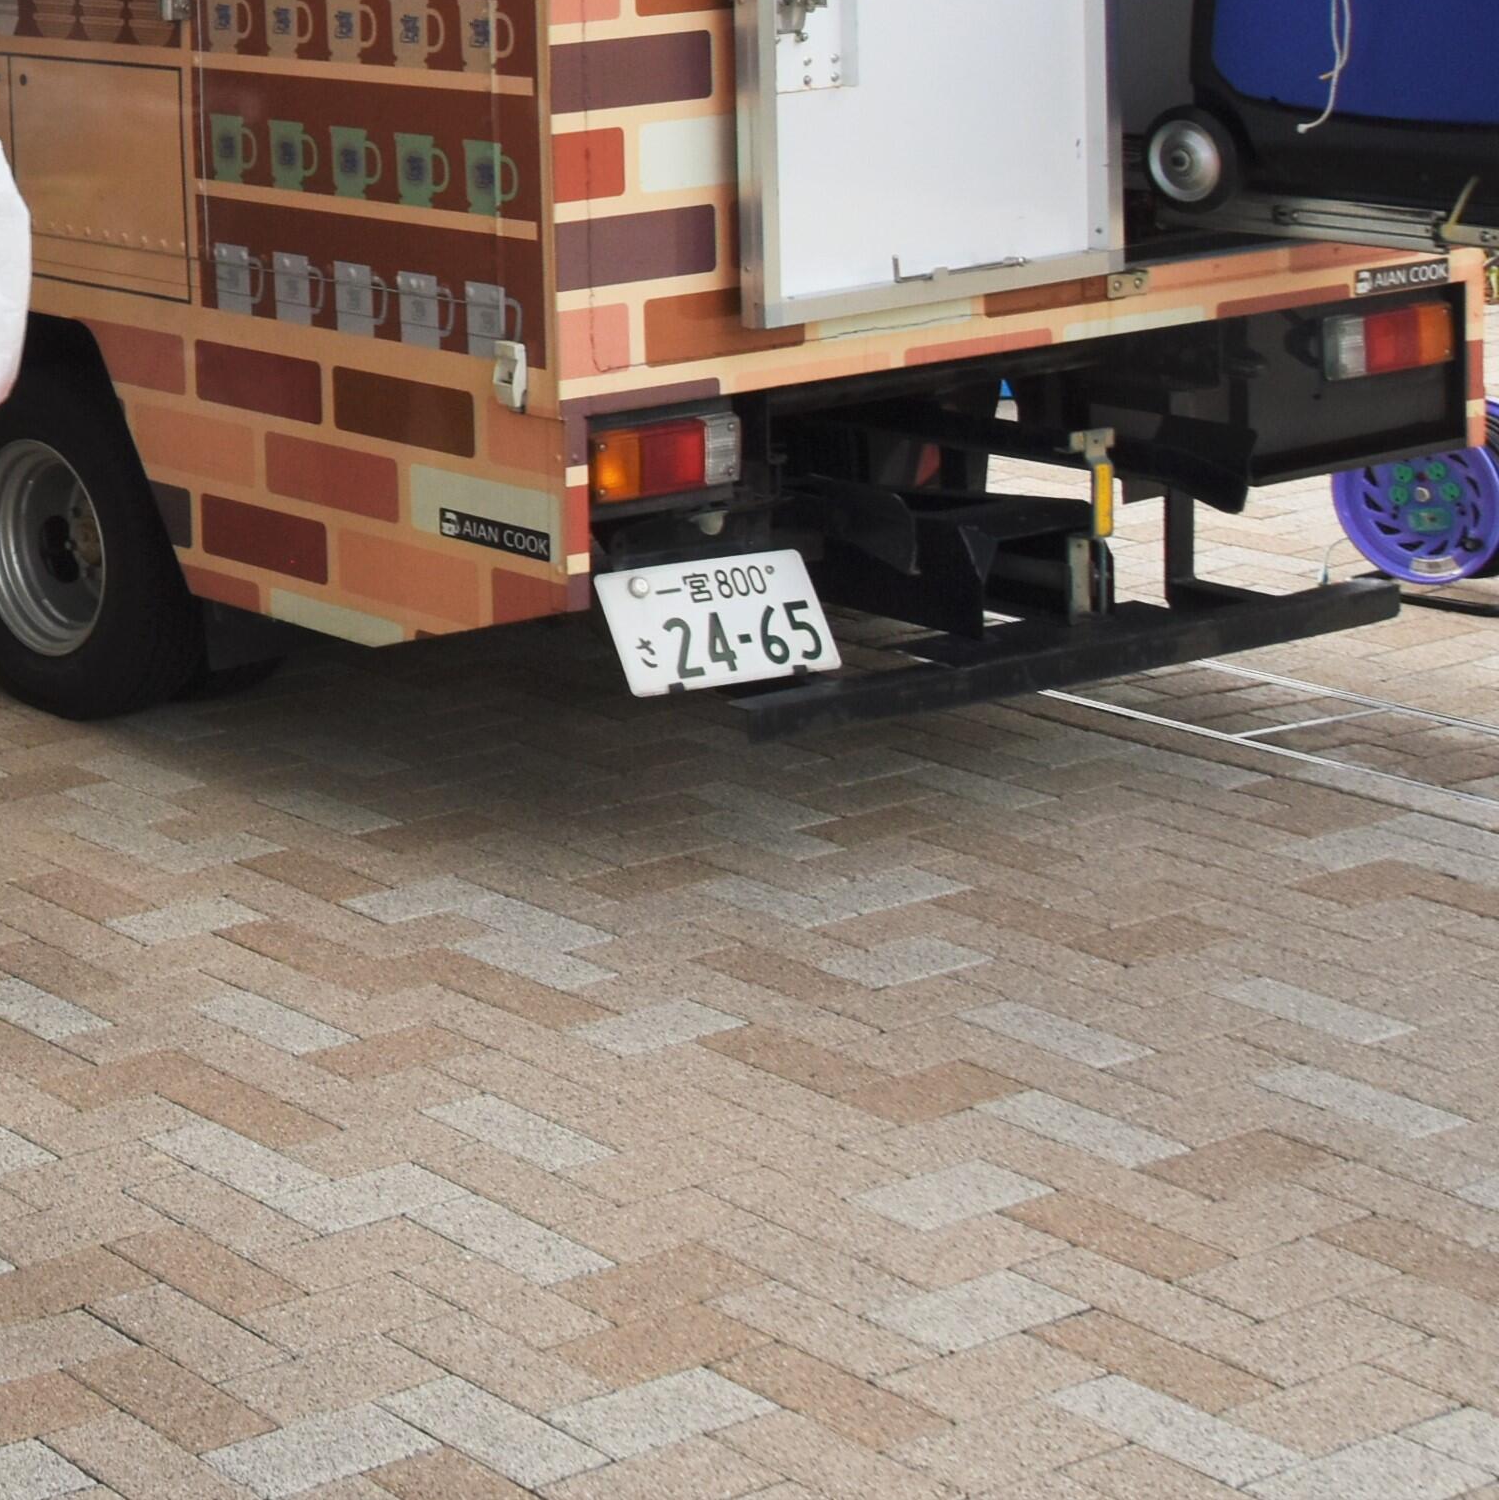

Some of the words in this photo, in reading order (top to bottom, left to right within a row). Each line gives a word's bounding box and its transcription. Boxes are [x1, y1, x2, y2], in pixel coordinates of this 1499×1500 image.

[1409, 263, 1449, 283] COOK
[462, 520, 500, 543] AIAN
[503, 530, 549, 556] COOK
[662, 599, 823, 680] 24-65
